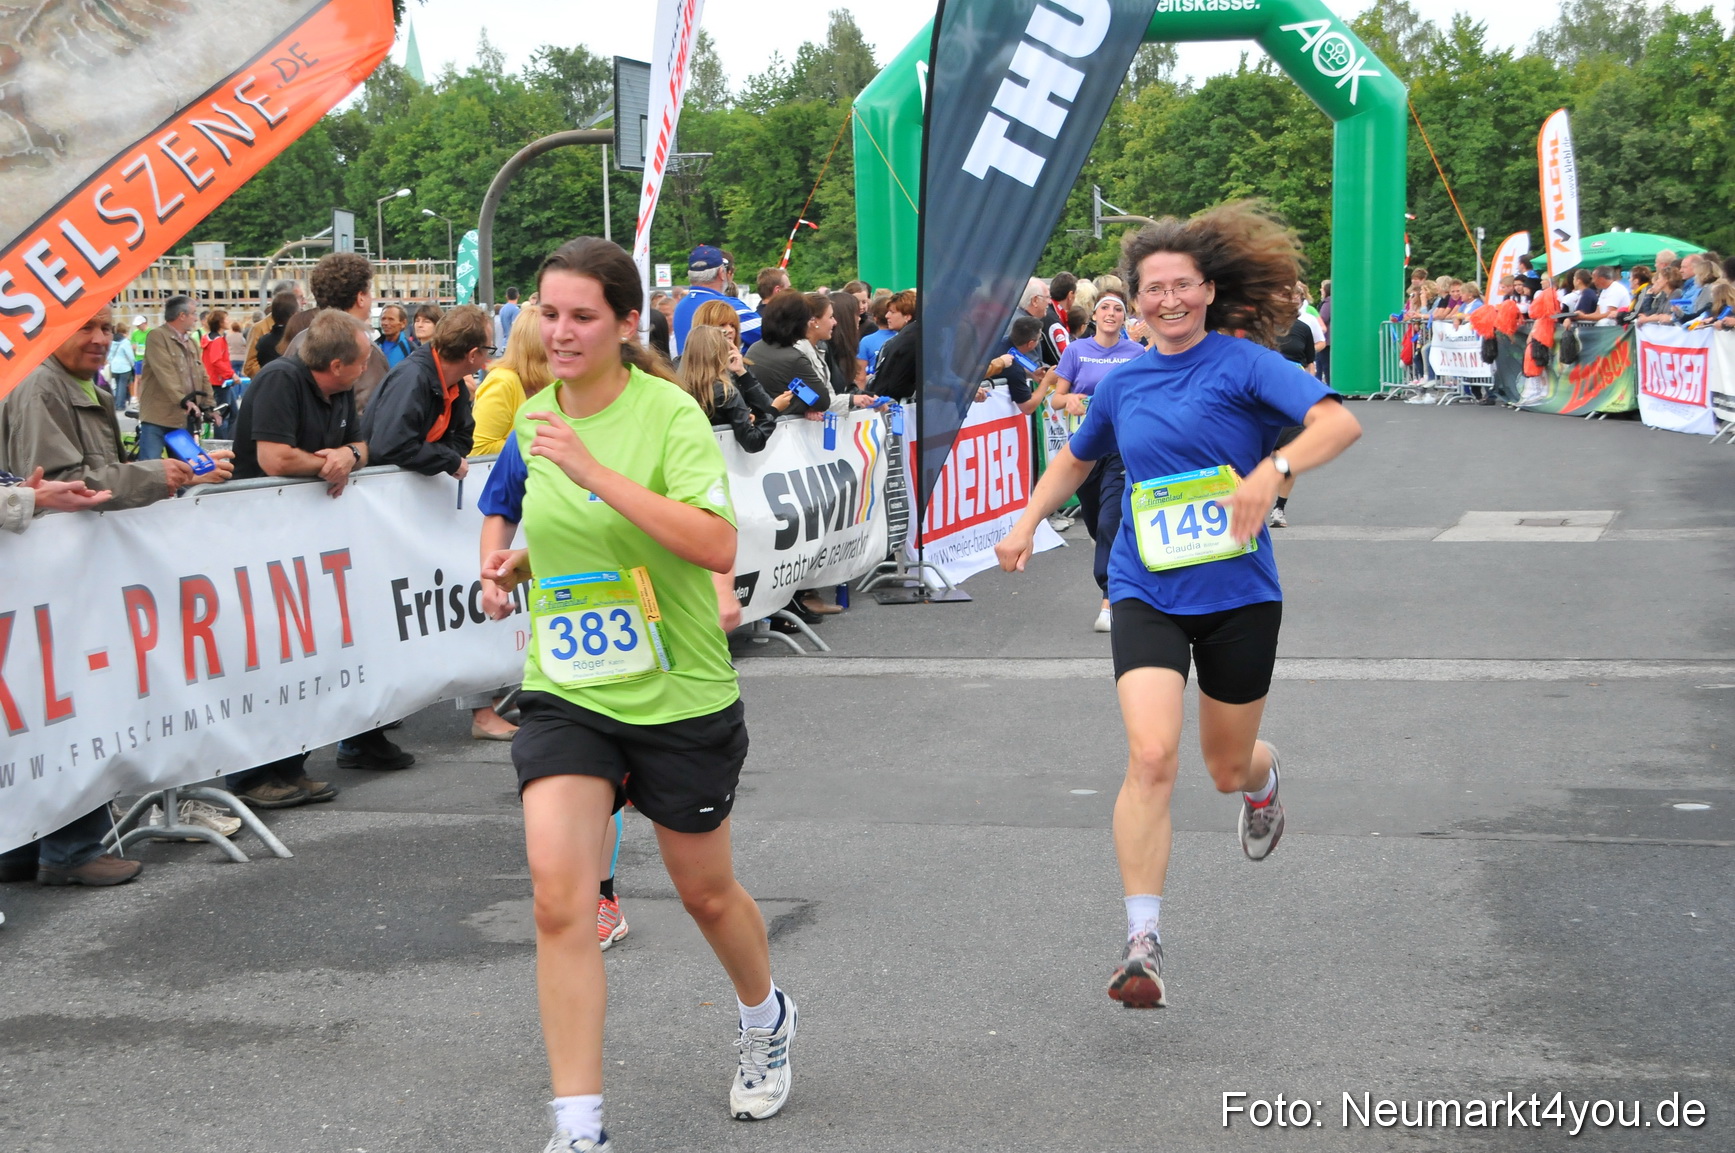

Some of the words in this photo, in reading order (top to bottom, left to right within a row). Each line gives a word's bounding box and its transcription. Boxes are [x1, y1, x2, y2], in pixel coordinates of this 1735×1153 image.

[1279, 19, 1382, 106] AOK
[0, 41, 319, 362] SELSZENE.DE
[1644, 348, 1705, 403] MEIER
[1150, 500, 1228, 546] 149
[1165, 542, 1201, 555] Claudia
[549, 608, 638, 661] 383
[573, 659, 605, 671] Röger
